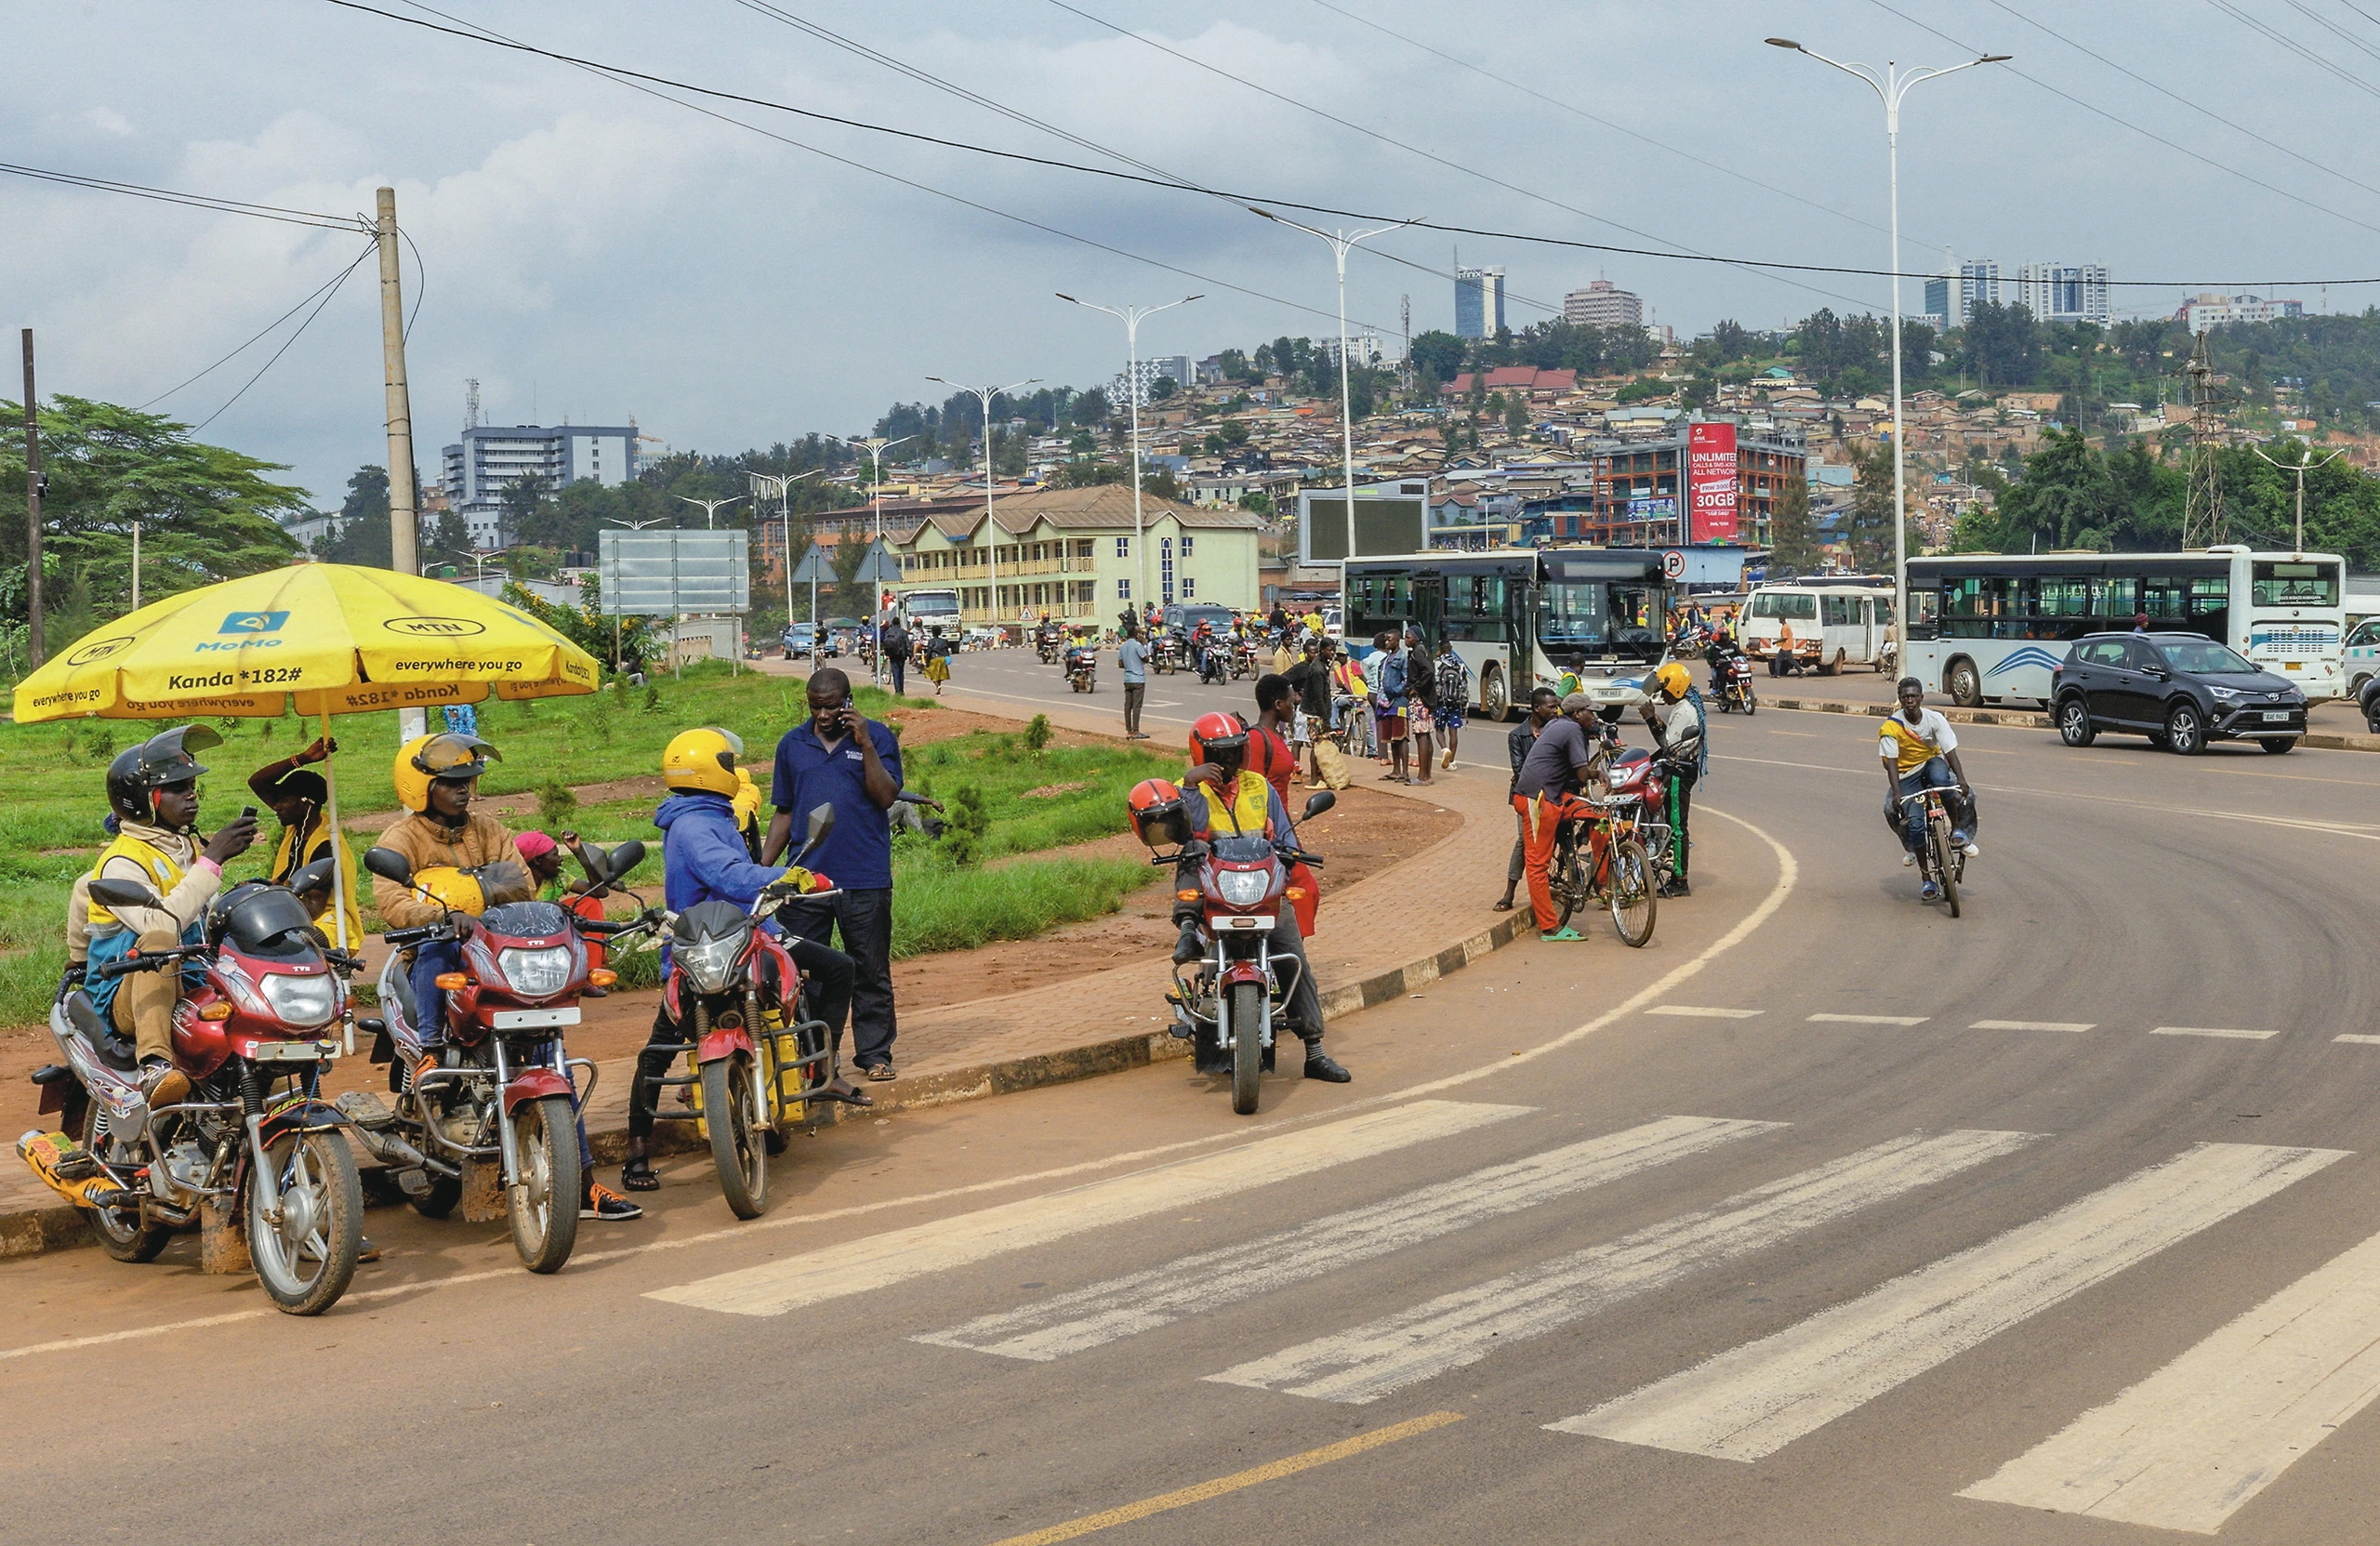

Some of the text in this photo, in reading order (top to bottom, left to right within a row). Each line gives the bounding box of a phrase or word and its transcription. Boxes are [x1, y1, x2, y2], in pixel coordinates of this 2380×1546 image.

[1670, 557, 1679, 572] P
[405, 622, 463, 633] MTN
[84, 644, 120, 658] MTN
[395, 657, 522, 672] everywhere you go
[168, 671, 234, 690] Kanda
[33, 689, 100, 707] everywhere you go
